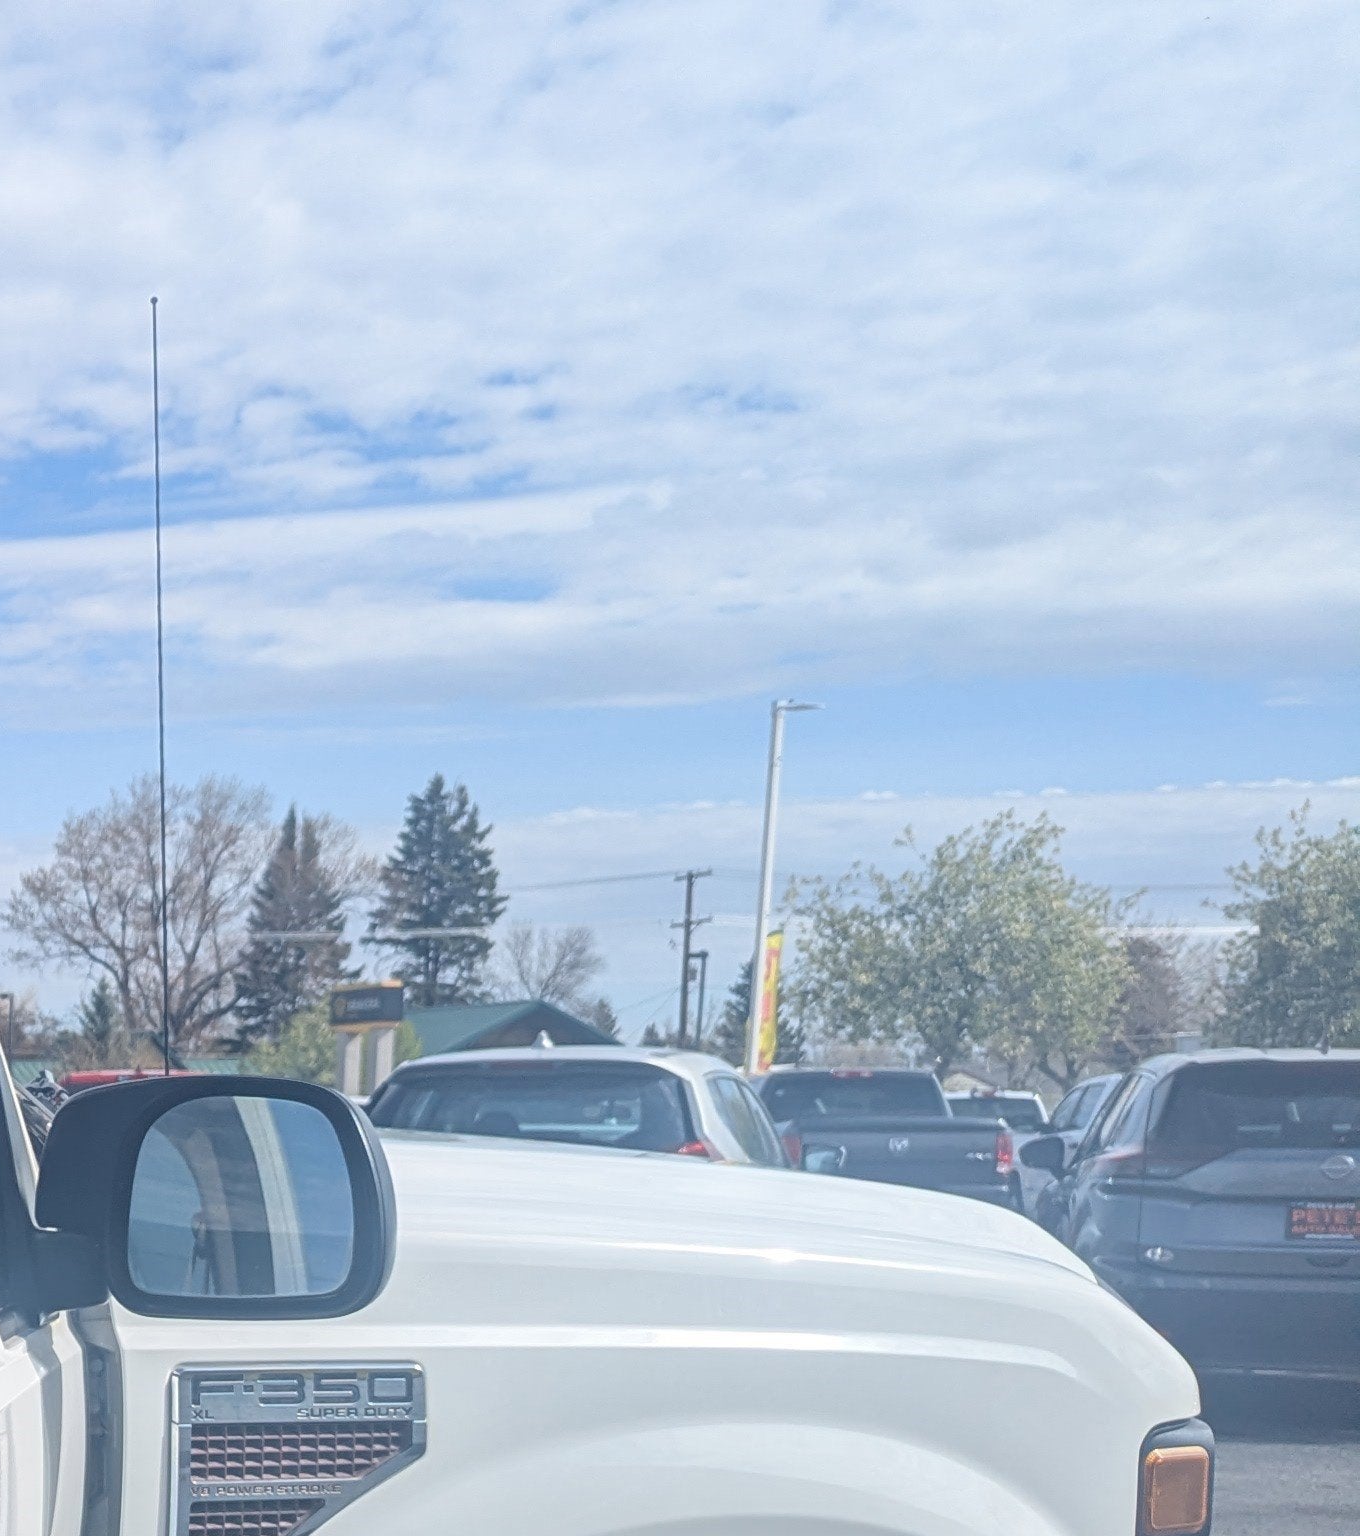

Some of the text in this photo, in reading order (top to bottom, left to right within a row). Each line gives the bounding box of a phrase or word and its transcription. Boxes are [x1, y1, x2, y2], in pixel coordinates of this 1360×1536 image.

[191, 1408, 215, 1421] XL
[296, 1406, 414, 1420] SUPER DUTY
[190, 1486, 211, 1497] V8
